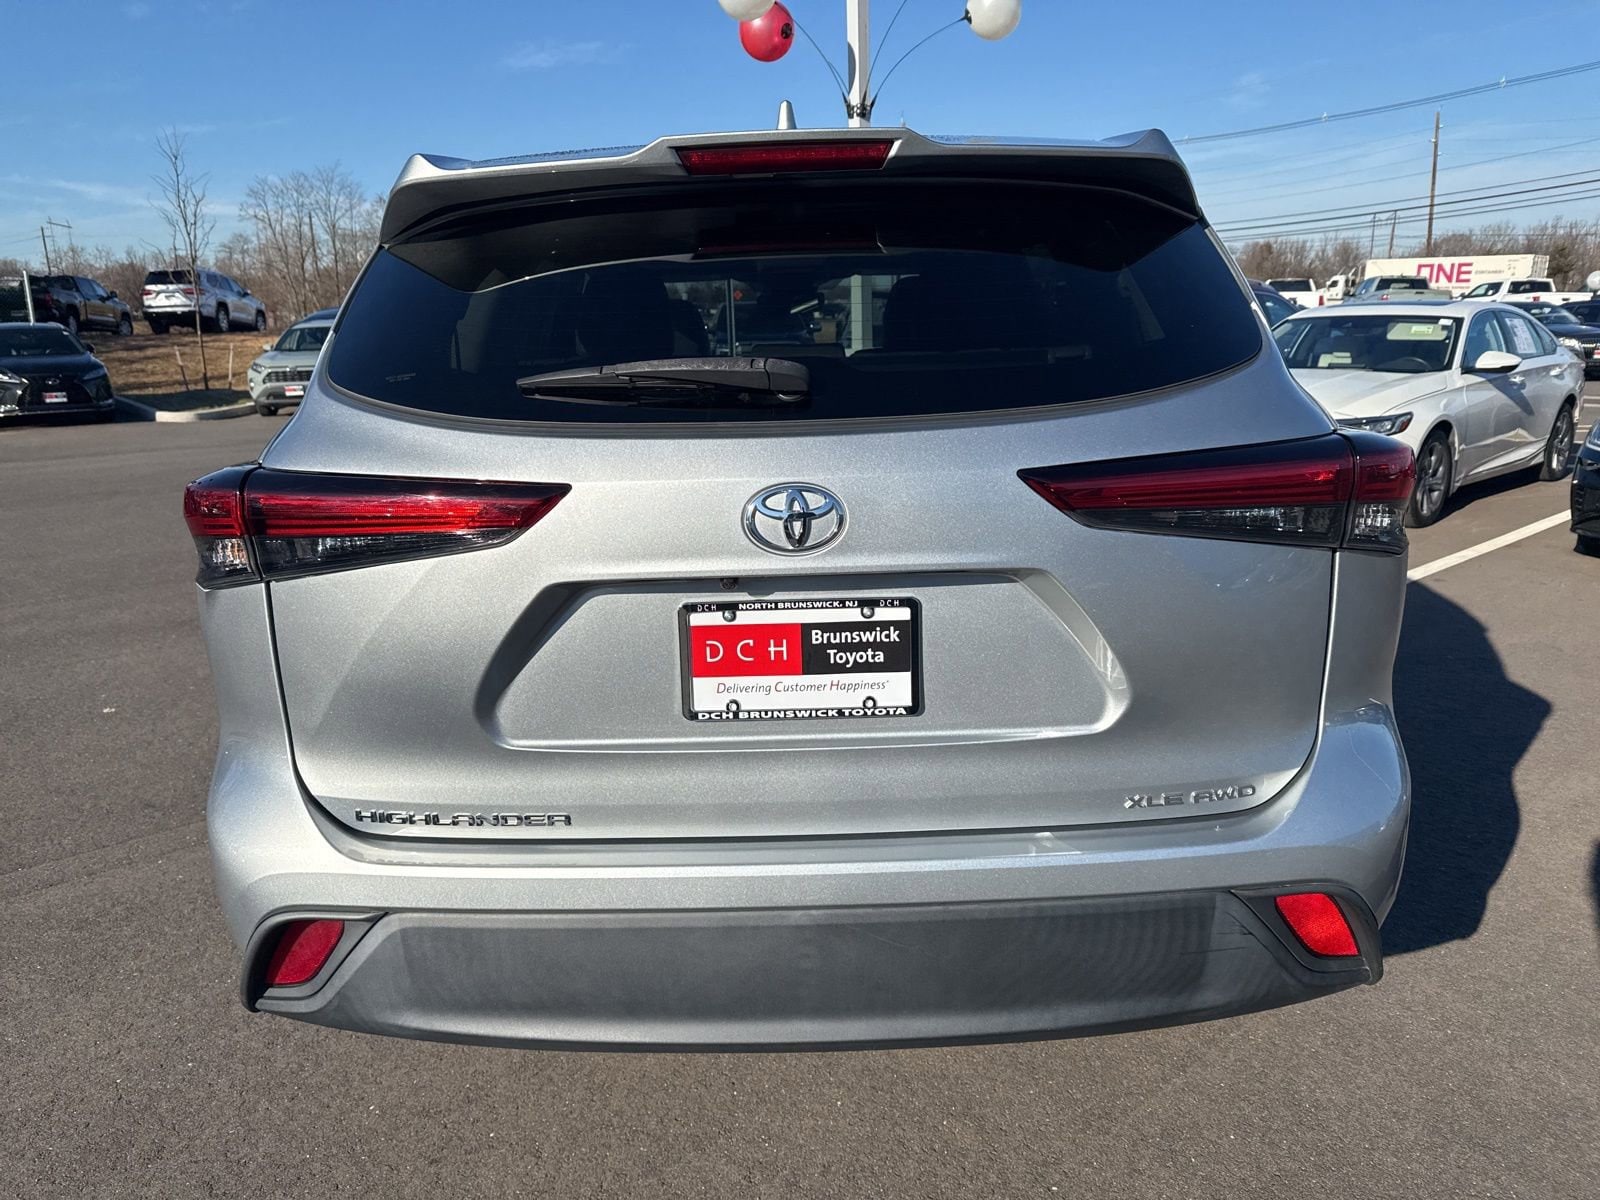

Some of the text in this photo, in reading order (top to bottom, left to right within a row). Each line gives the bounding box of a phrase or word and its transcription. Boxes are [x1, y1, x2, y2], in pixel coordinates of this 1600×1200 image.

[1416, 262, 1474, 283] ONE
[738, 602, 775, 610] NORTH
[845, 600, 858, 608] NJ
[811, 626, 900, 644] Brunswick
[827, 649, 885, 668] Toyota
[716, 680, 887, 695] Delivering Customer Happiness
[698, 707, 907, 720] DCH BRUNSWICK TOYOTA
[1123, 785, 1256, 809] XLE AWD
[354, 808, 572, 827] HIGHLANDER
